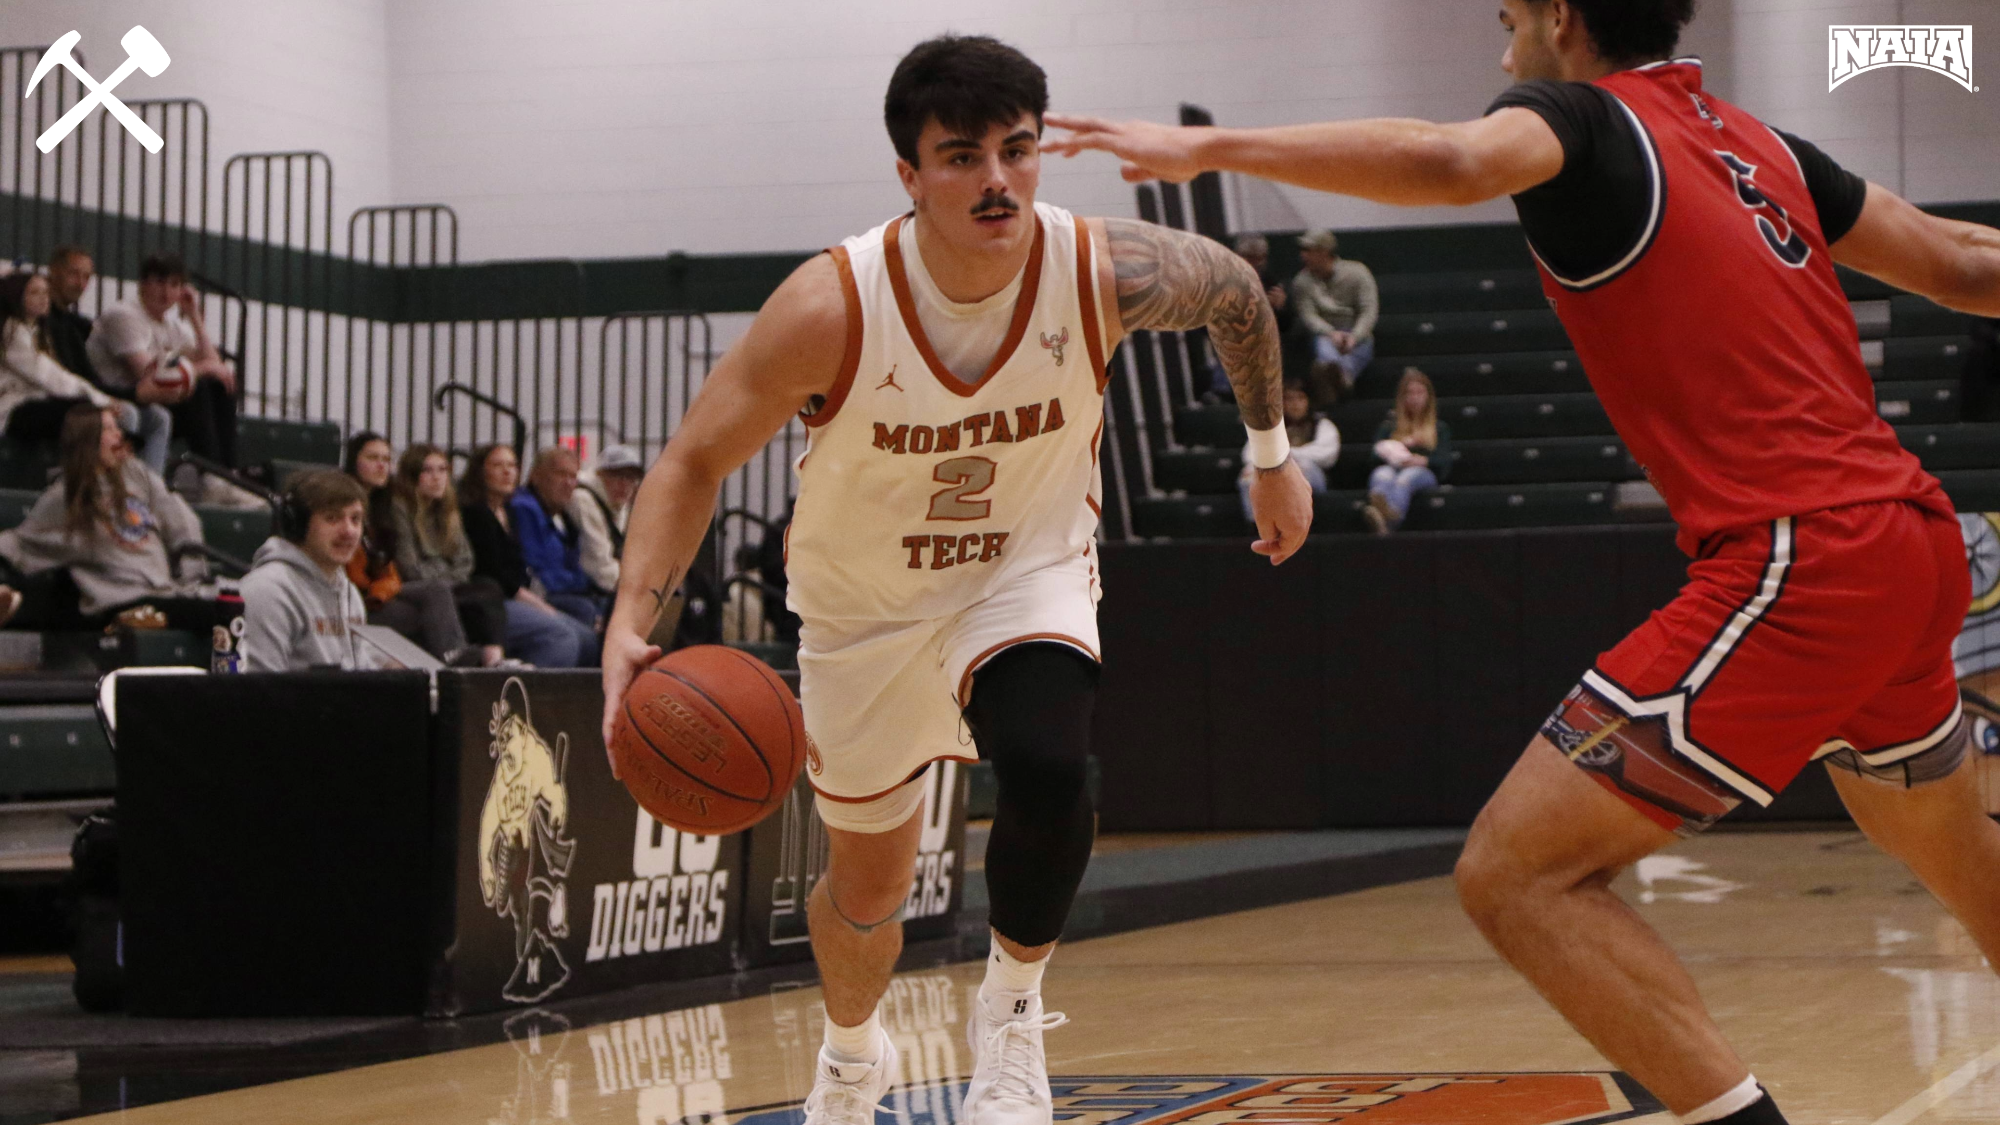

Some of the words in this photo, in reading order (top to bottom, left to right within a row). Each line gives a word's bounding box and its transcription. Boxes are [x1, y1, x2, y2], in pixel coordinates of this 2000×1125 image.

[1713, 149, 1812, 268] 5
[872, 397, 1066, 455] MONTANA
[925, 455, 998, 521] 2
[902, 532, 1010, 570] TECH
[585, 869, 729, 962] DIGGERS
